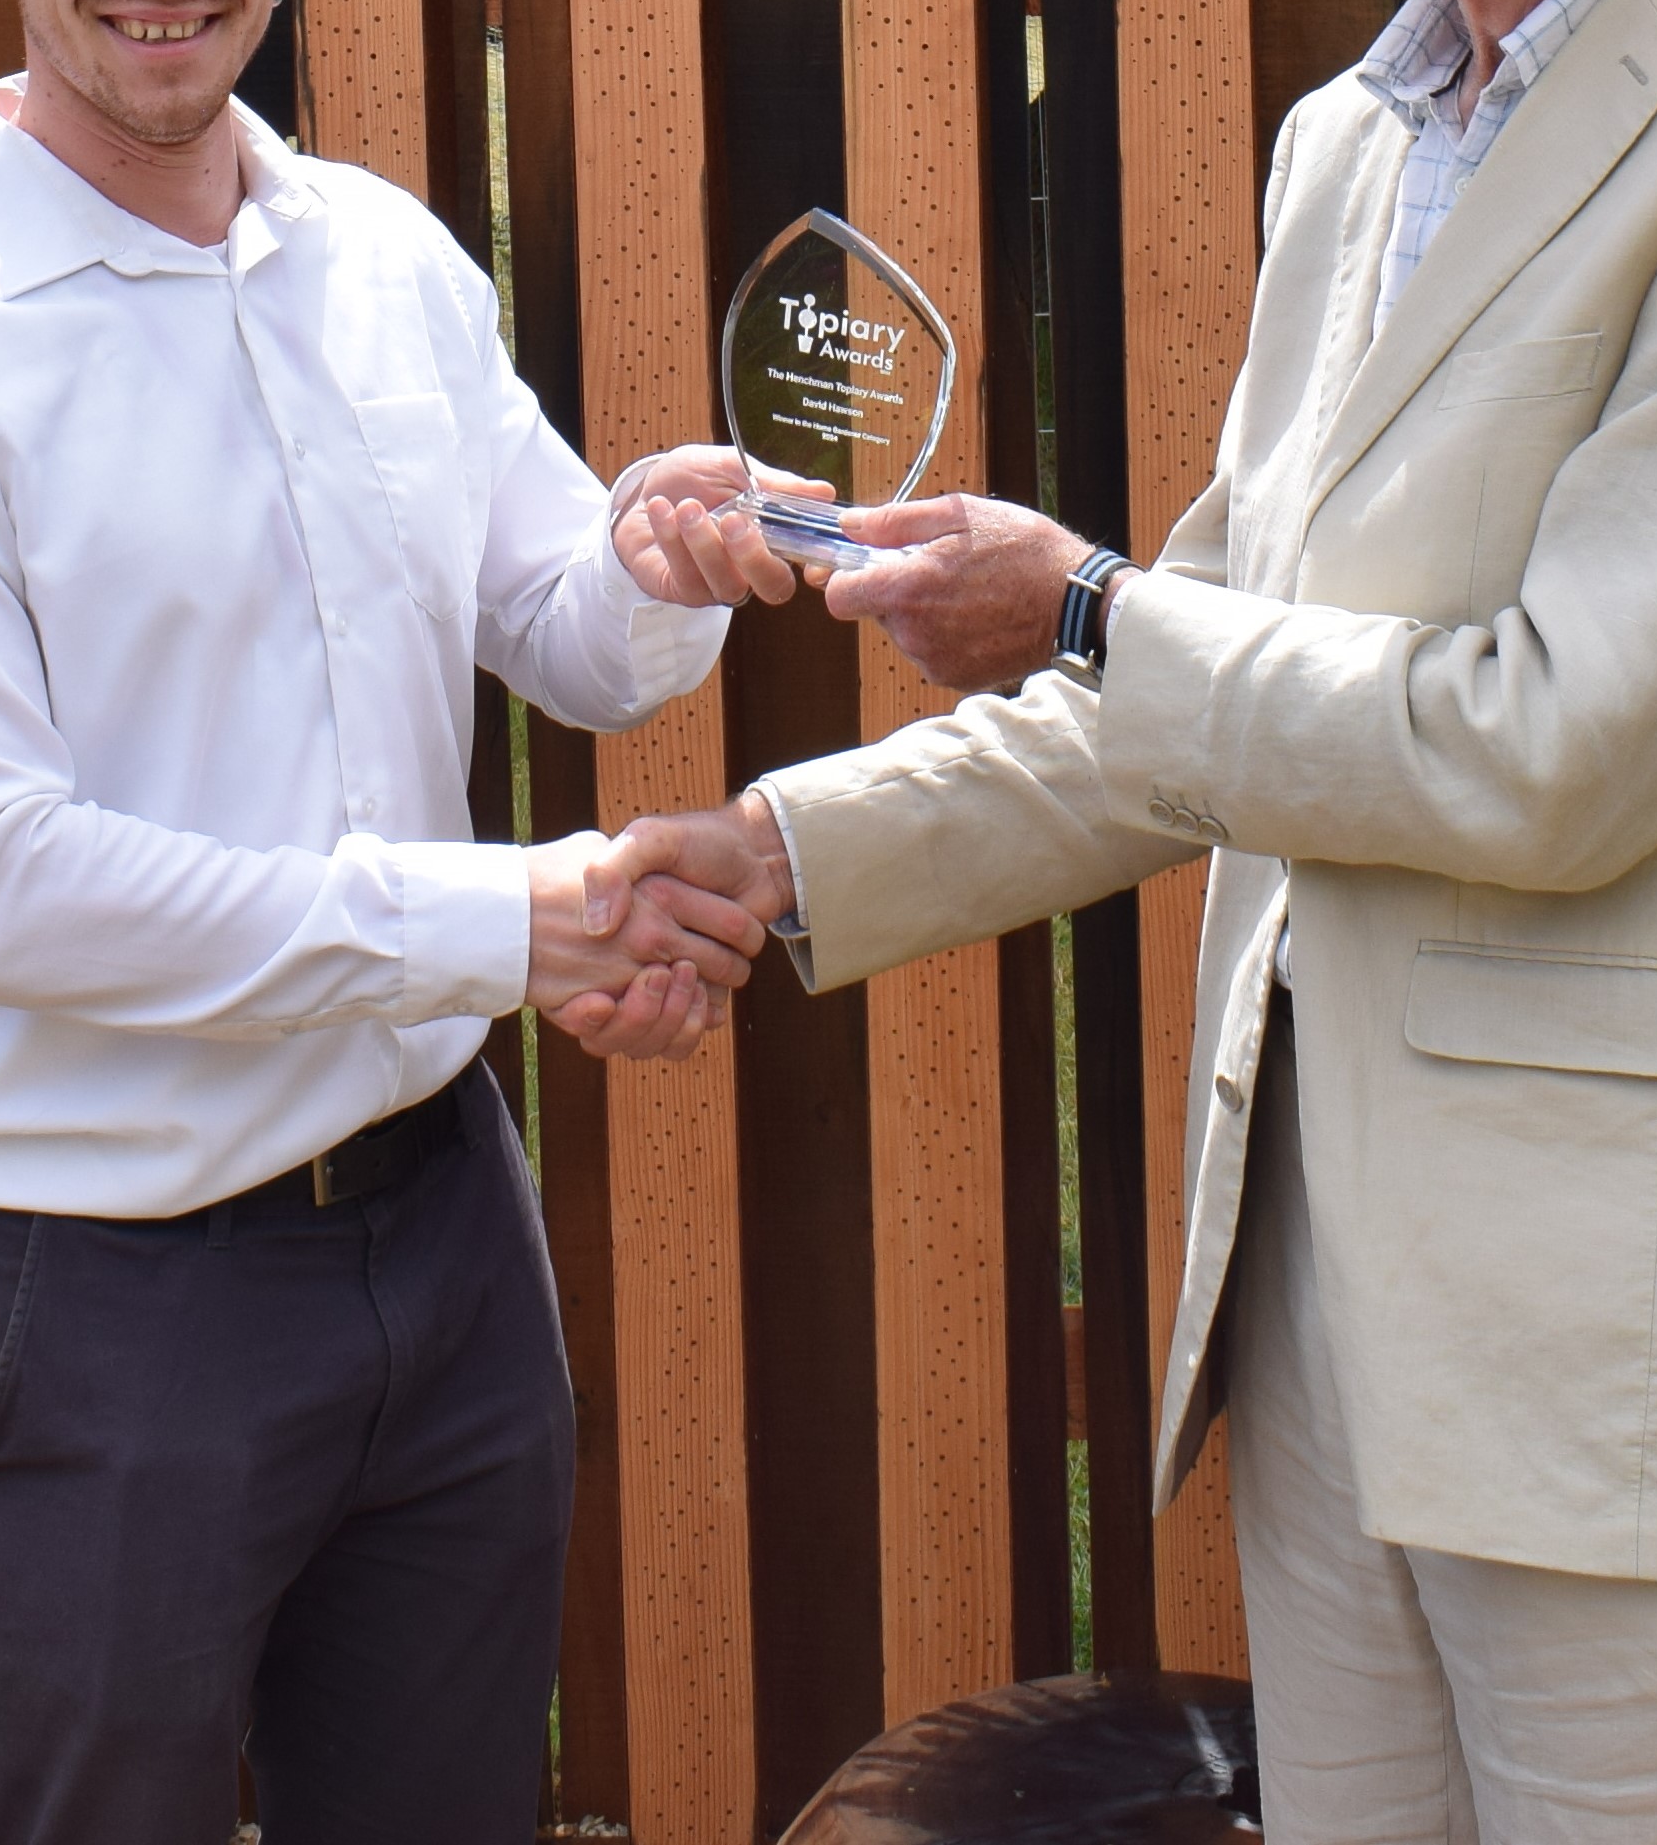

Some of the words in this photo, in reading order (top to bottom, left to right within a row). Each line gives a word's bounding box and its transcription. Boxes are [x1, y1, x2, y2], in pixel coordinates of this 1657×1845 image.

[779, 294, 905, 353] Topiary
[819, 339, 893, 371] Awards
[768, 367, 784, 380] The
[786, 371, 834, 391] Henchman
[836, 381, 868, 399] Topiary
[870, 389, 903, 405] Awards
[803, 397, 827, 411] David
